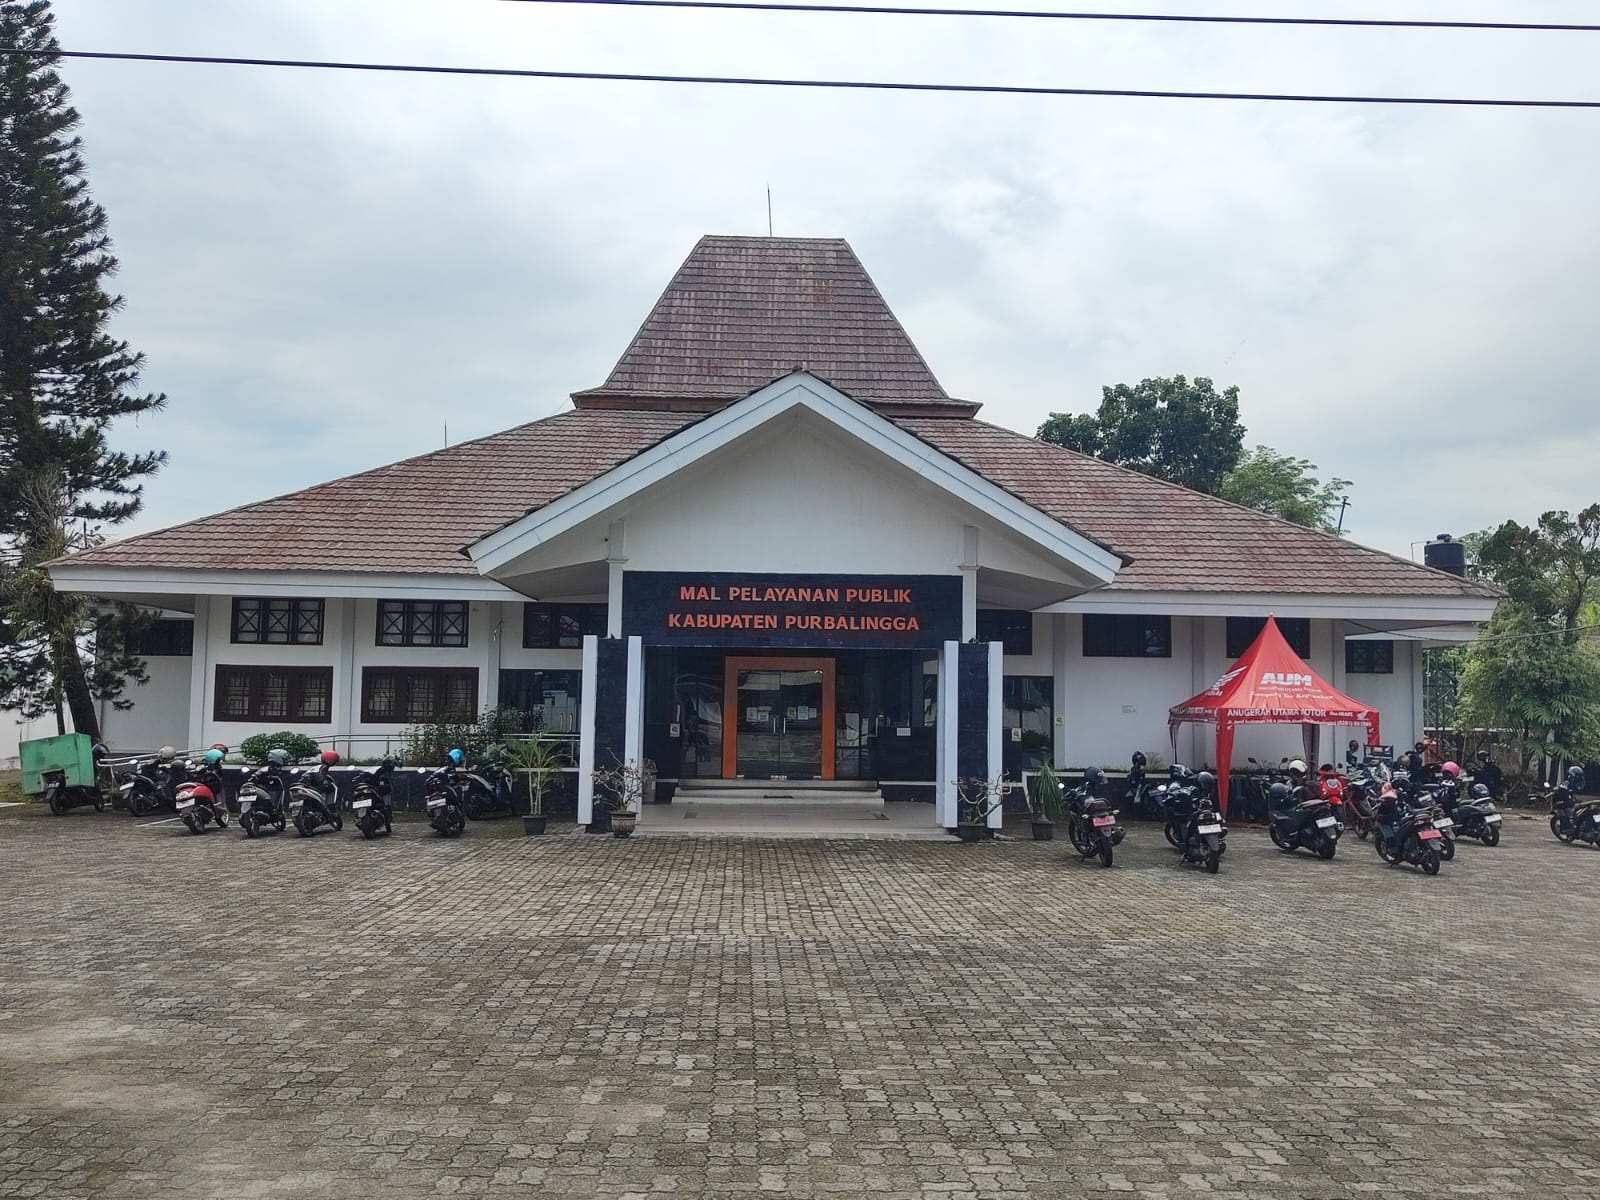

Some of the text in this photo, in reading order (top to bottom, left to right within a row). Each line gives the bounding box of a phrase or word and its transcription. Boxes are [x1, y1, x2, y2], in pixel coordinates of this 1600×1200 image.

[680, 586, 911, 603] MAL PELAYANAN PUBLIK
[668, 613, 920, 631] KABUPATEN PURBALINGGA
[1261, 672, 1312, 686] AUM
[1227, 708, 1271, 717] ANUGERAH
[1272, 708, 1299, 716] UTAMA
